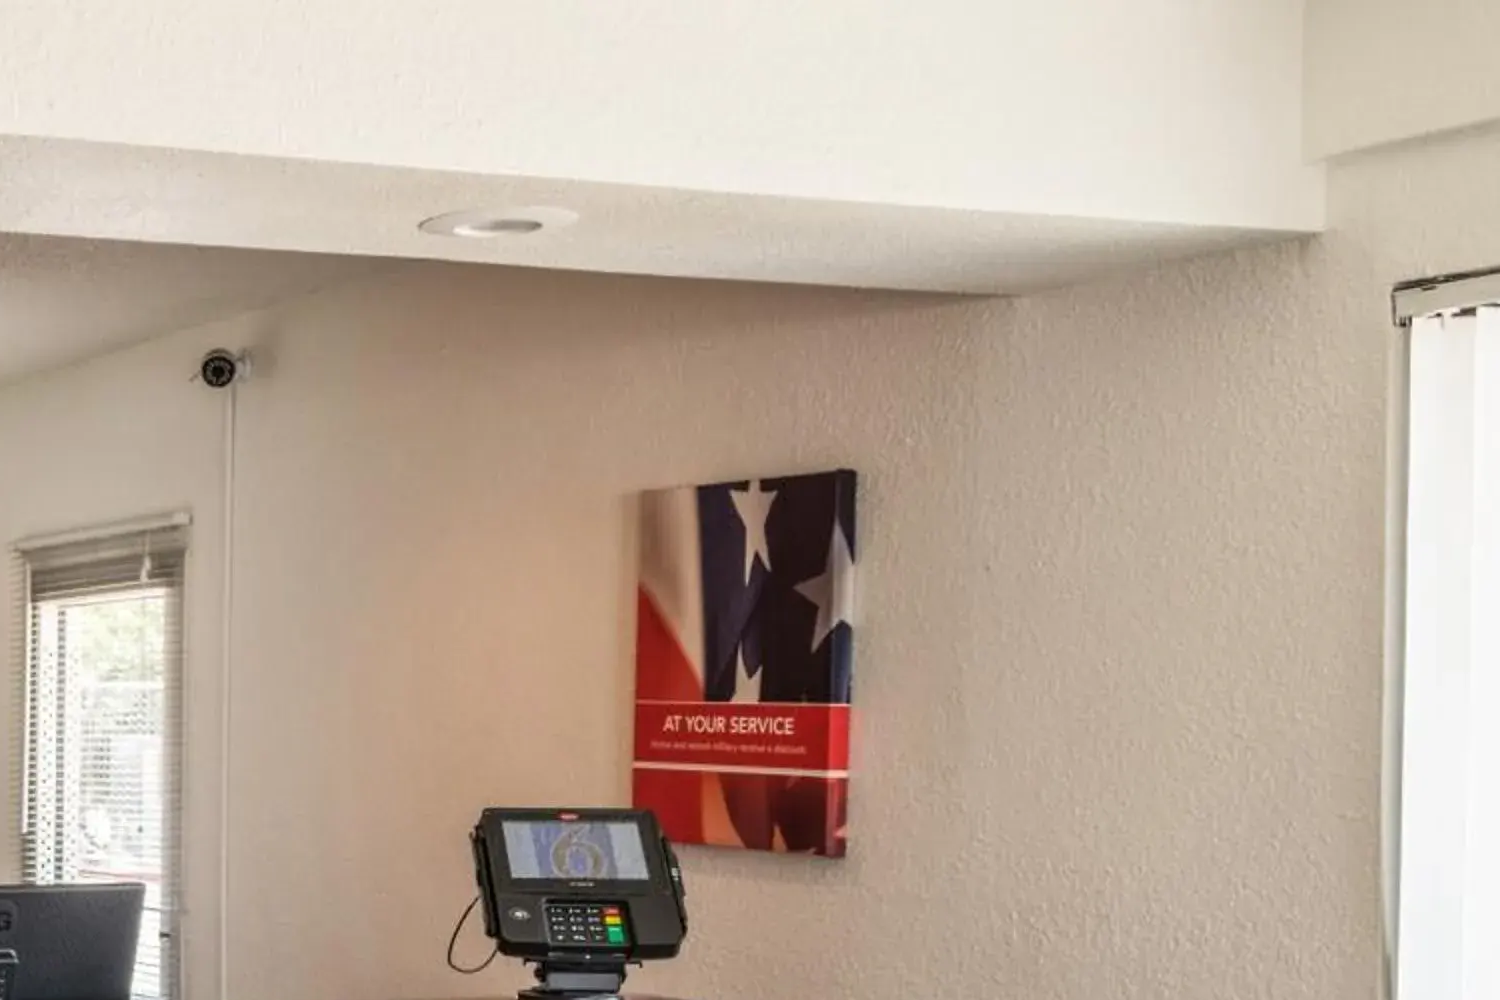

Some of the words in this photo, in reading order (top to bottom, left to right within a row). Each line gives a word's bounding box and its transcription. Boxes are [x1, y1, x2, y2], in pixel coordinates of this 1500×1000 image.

[662, 714, 683, 732] AT
[685, 715, 727, 734] YOUR
[729, 716, 796, 736] SERVICE
